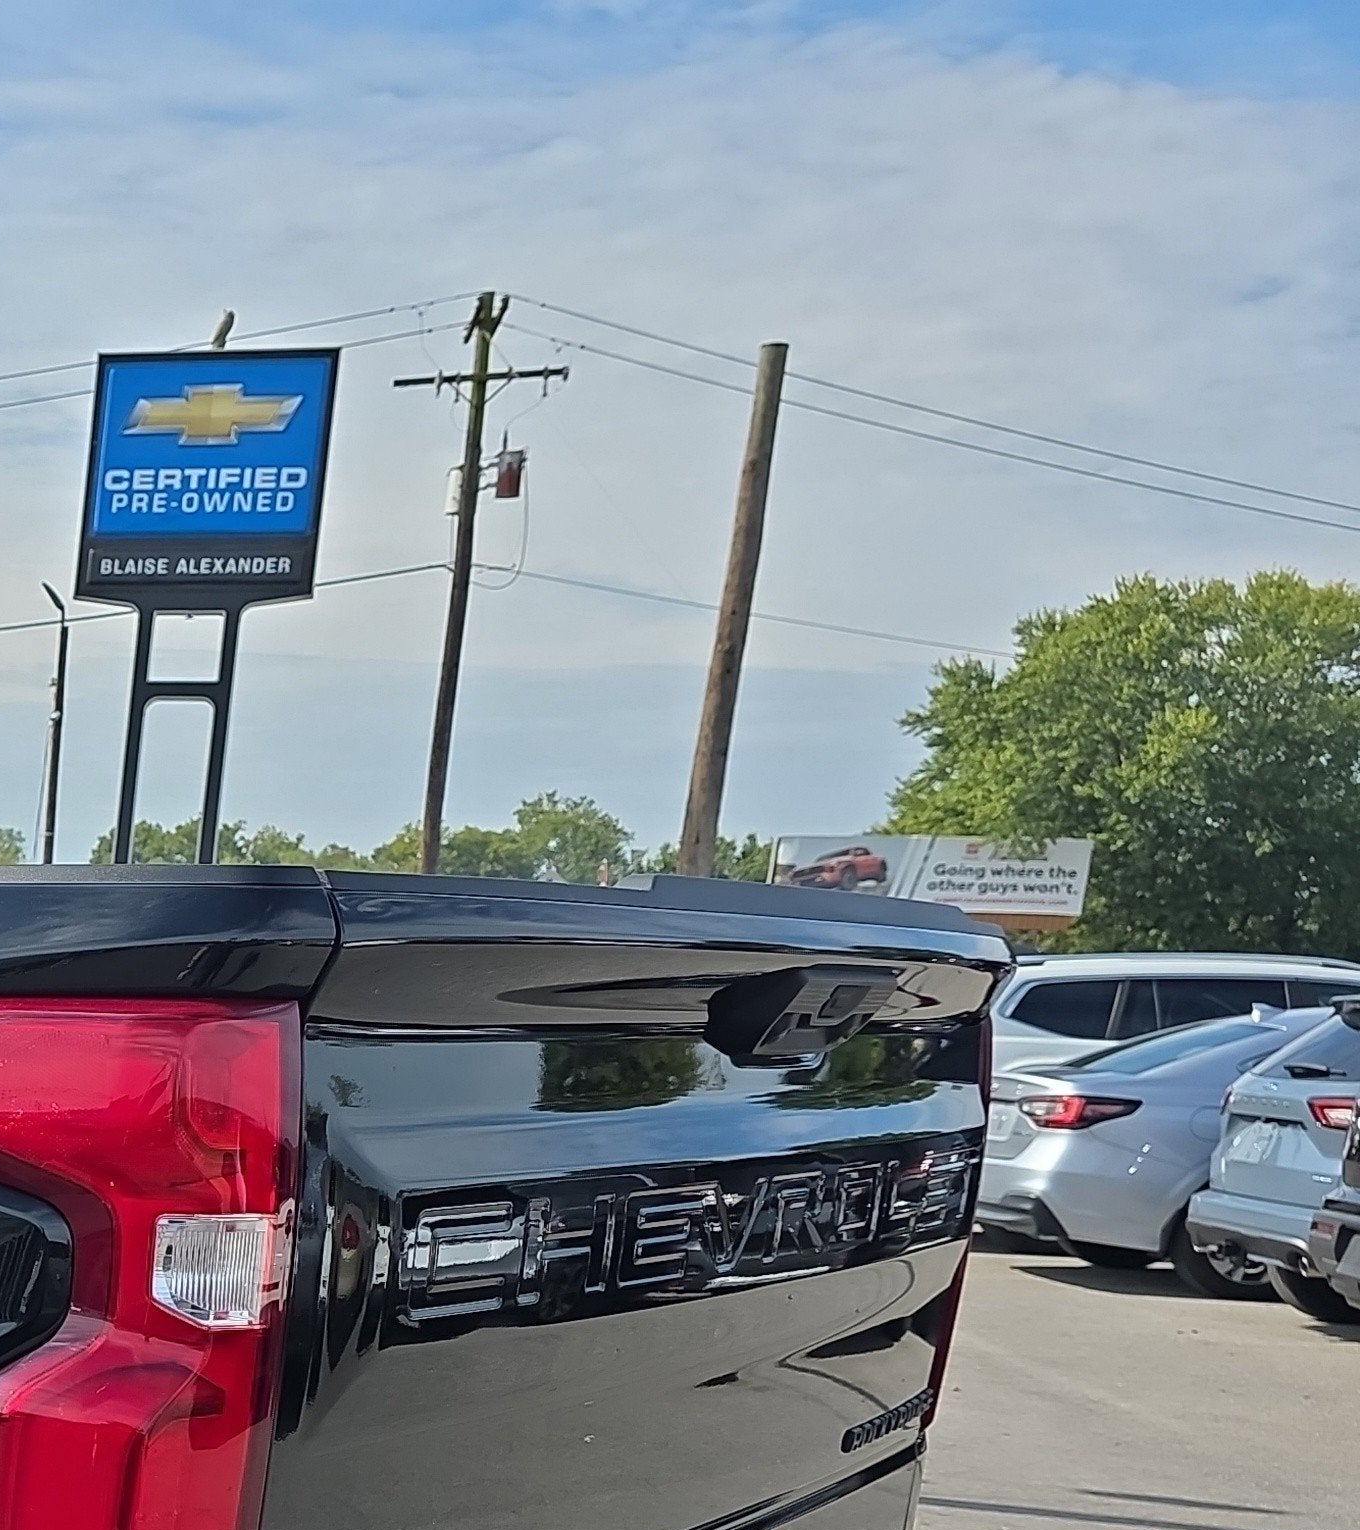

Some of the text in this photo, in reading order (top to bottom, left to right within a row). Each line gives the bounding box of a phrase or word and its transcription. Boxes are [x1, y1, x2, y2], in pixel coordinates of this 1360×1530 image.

[103, 466, 308, 491] CERTIFIED
[111, 491, 295, 514] PRE-OWNED
[99, 556, 291, 575] BLAISE ALEXANDER
[933, 863, 1078, 880] Going where the
[926, 879, 973, 892] other
[977, 882, 1018, 895] guys
[407, 1147, 980, 1321] CHEVROLET
